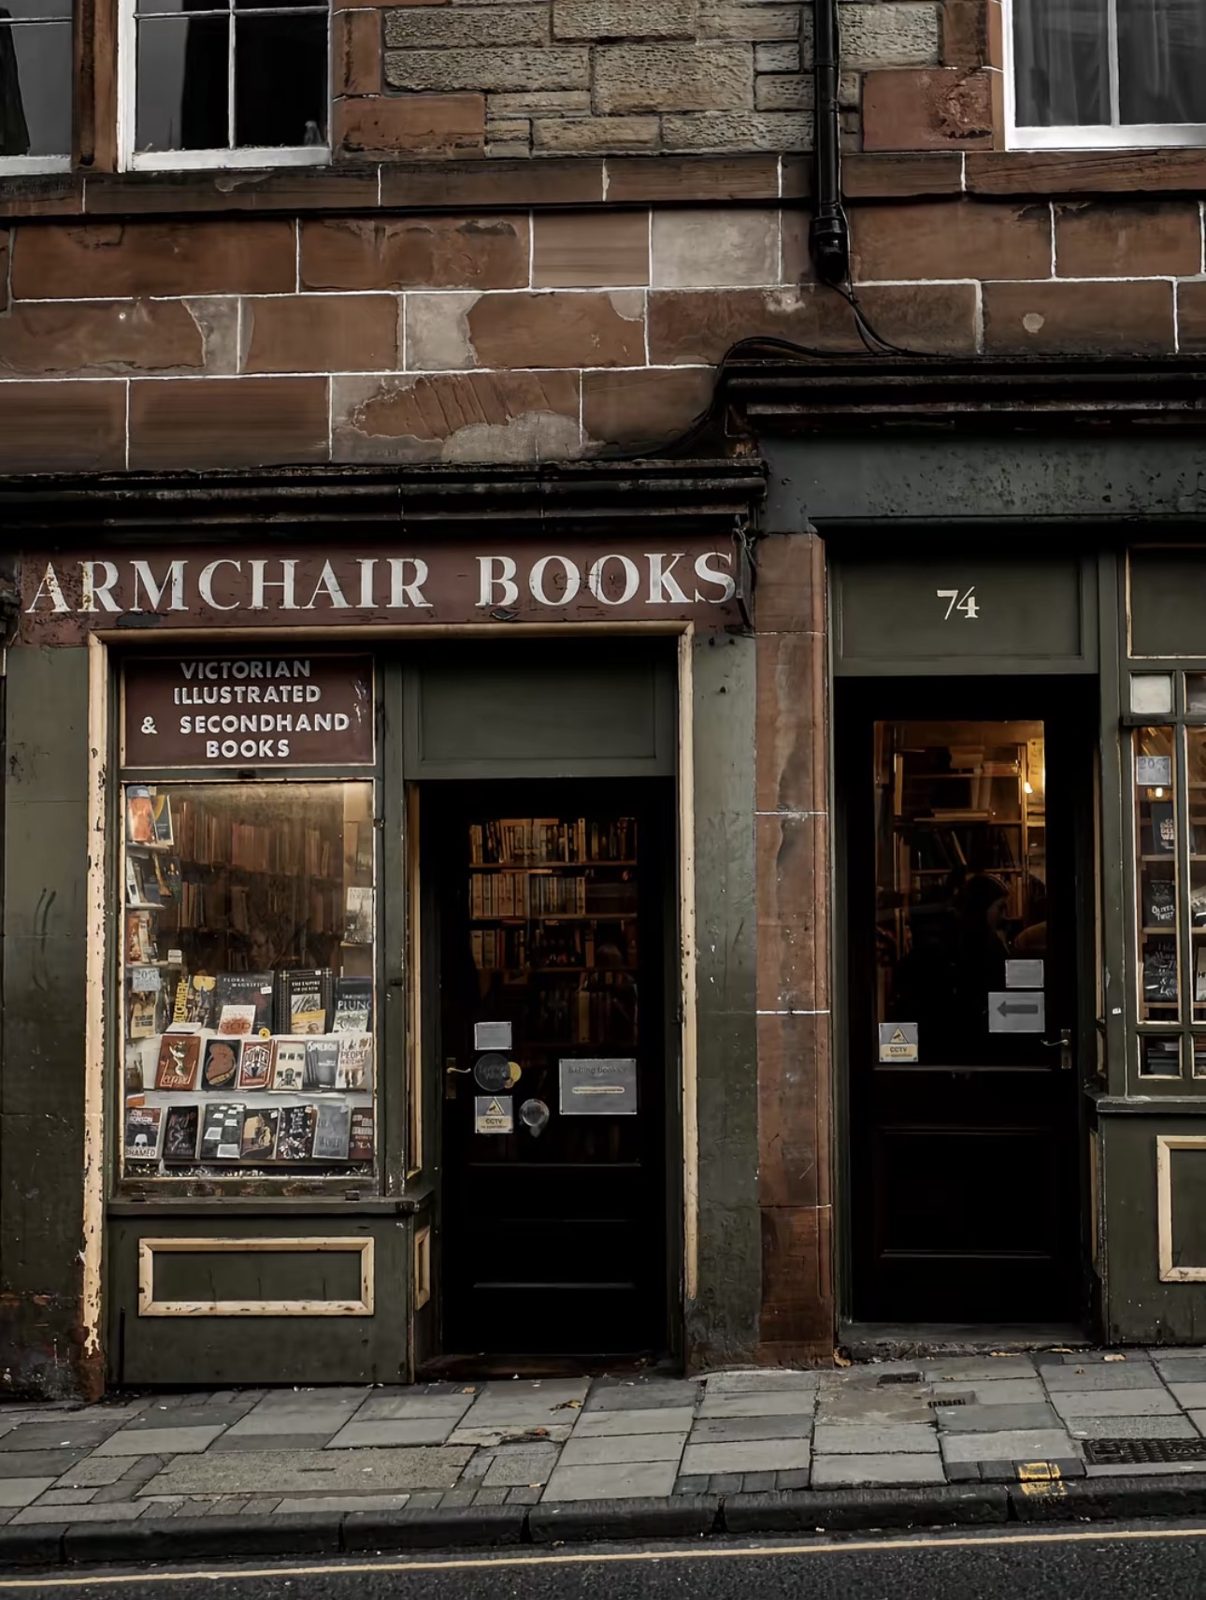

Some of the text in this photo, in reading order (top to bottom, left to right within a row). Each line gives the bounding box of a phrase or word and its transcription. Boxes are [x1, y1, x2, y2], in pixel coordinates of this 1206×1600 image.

[24, 552, 736, 614] ARMCHAIR BOOKS
[936, 586, 980, 620] 74
[180, 660, 311, 679] VICTORIAN
[174, 685, 321, 705] ILLUSTRATED
[141, 713, 350, 734] & SECONDHAND
[206, 739, 291, 758] BOOKS
